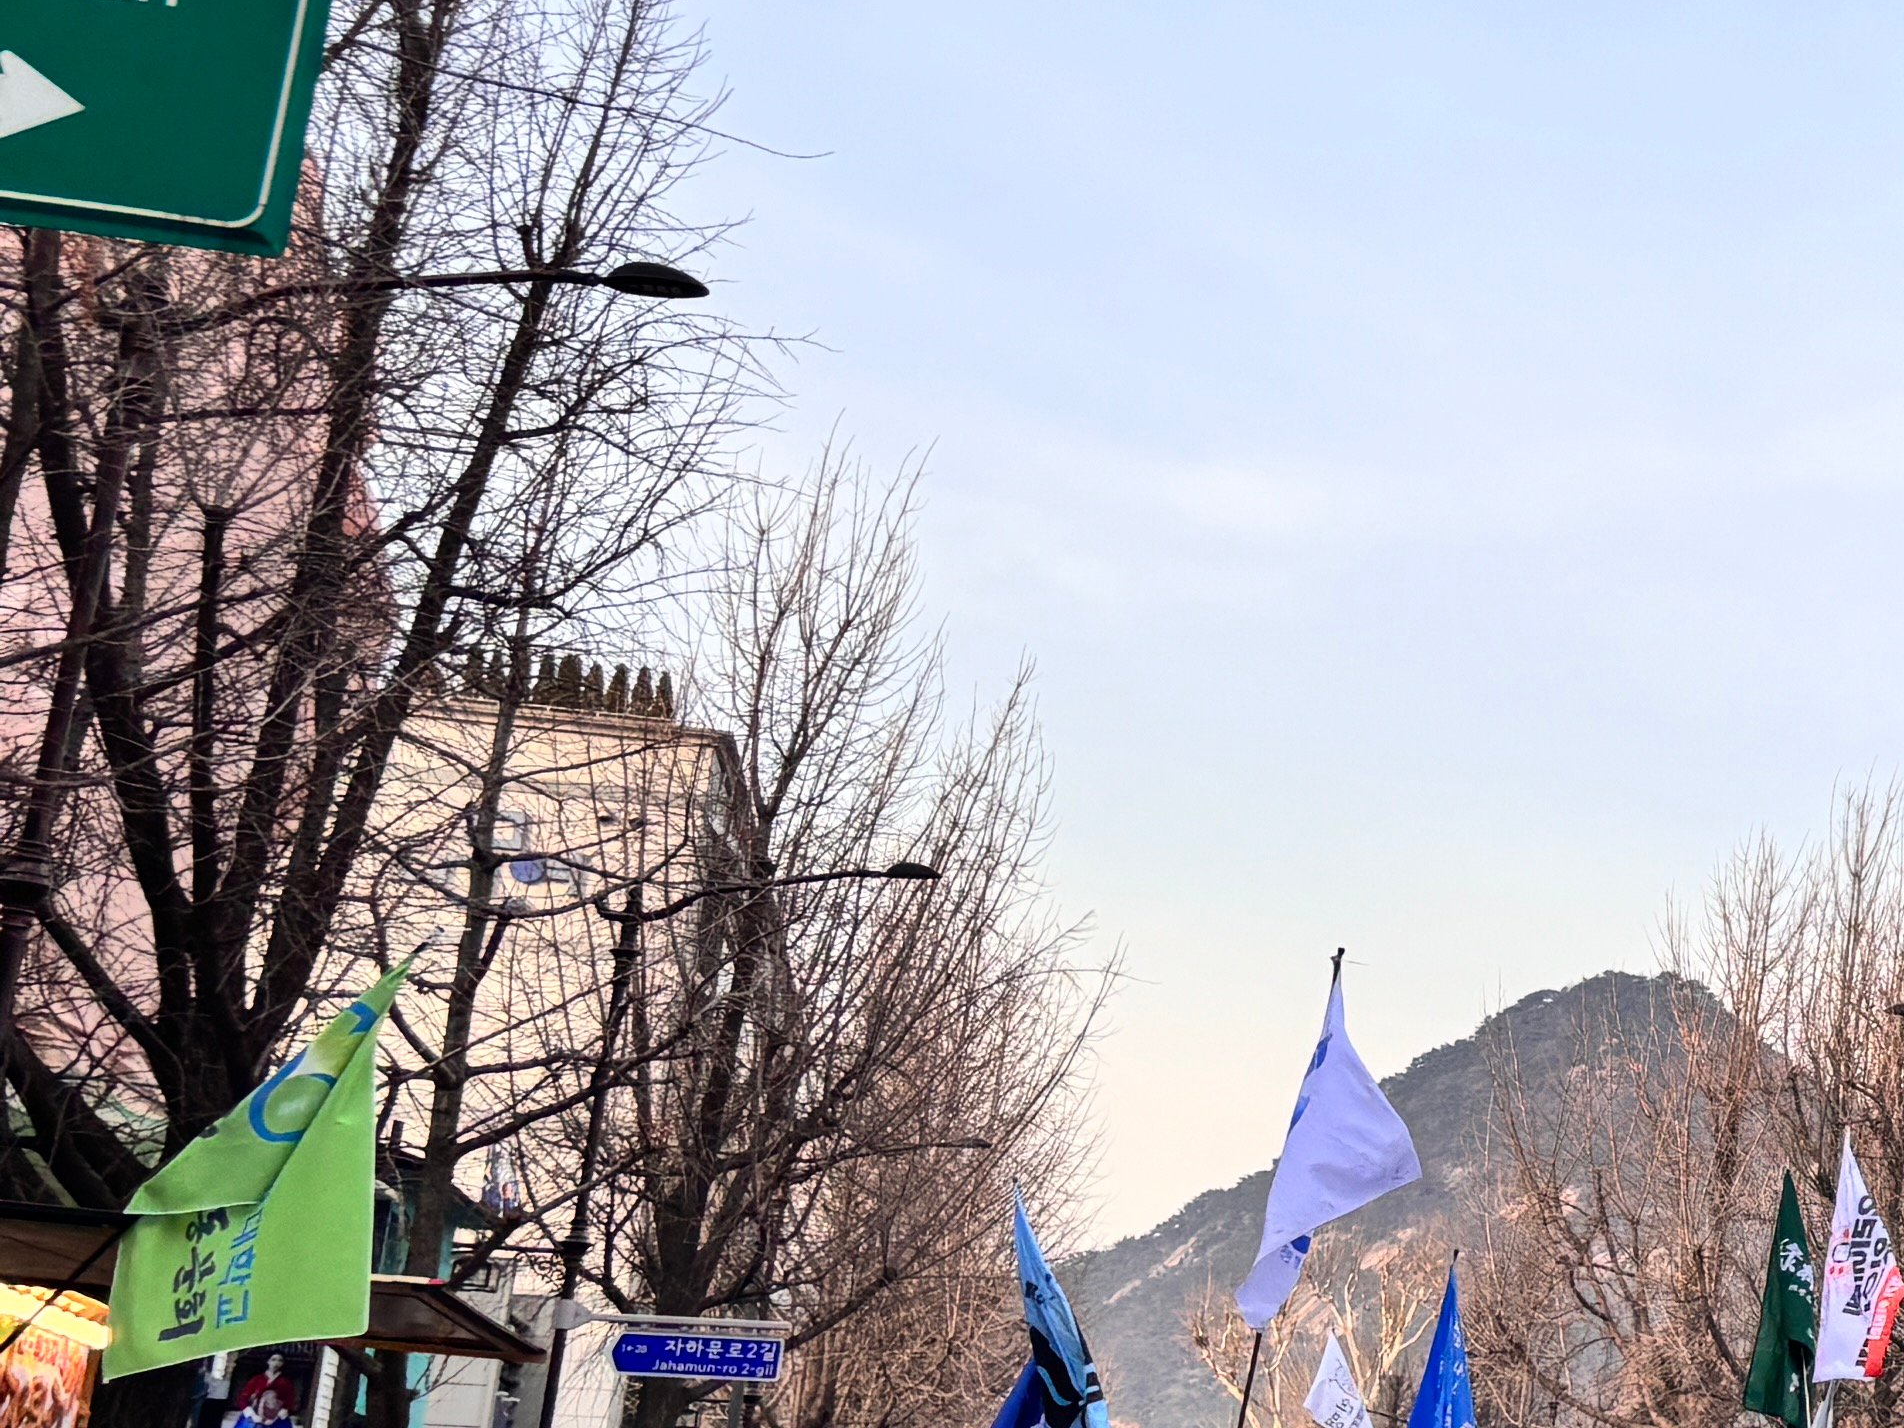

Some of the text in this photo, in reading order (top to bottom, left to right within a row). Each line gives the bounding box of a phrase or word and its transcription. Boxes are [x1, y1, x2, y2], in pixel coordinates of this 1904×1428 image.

[664, 1338, 777, 1362] 자하문로2길
[652, 1359, 774, 1377] Jahamun-ro 2-gil
